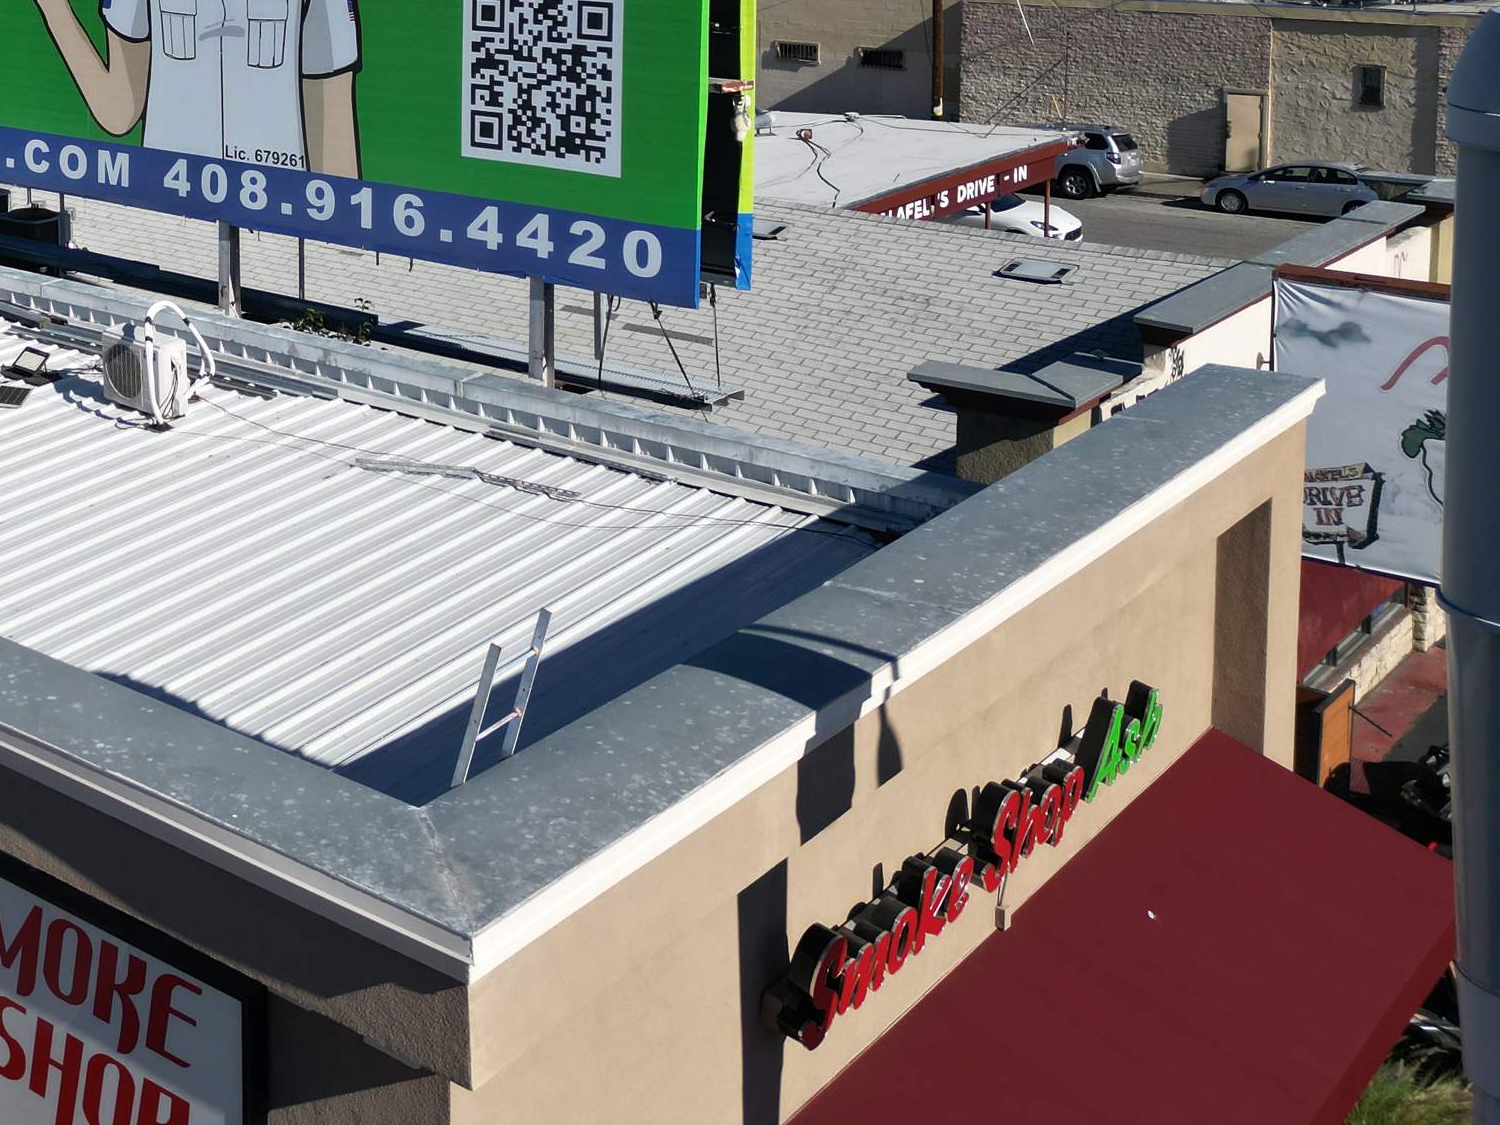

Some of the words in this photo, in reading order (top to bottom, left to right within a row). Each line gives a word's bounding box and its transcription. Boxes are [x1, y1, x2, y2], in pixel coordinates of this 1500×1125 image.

[225, 145, 250, 161] Lic.
[255, 149, 305, 168] 679261
[957, 175, 995, 203] DRIVE
[1013, 165, 1028, 183] IN
[164, 158, 663, 277] 408.916.4420
[1303, 485, 1365, 507] RIVE
[1313, 507, 1344, 525] IN
[802, 856, 974, 1050] Smoke
[981, 765, 1084, 892] Shop
